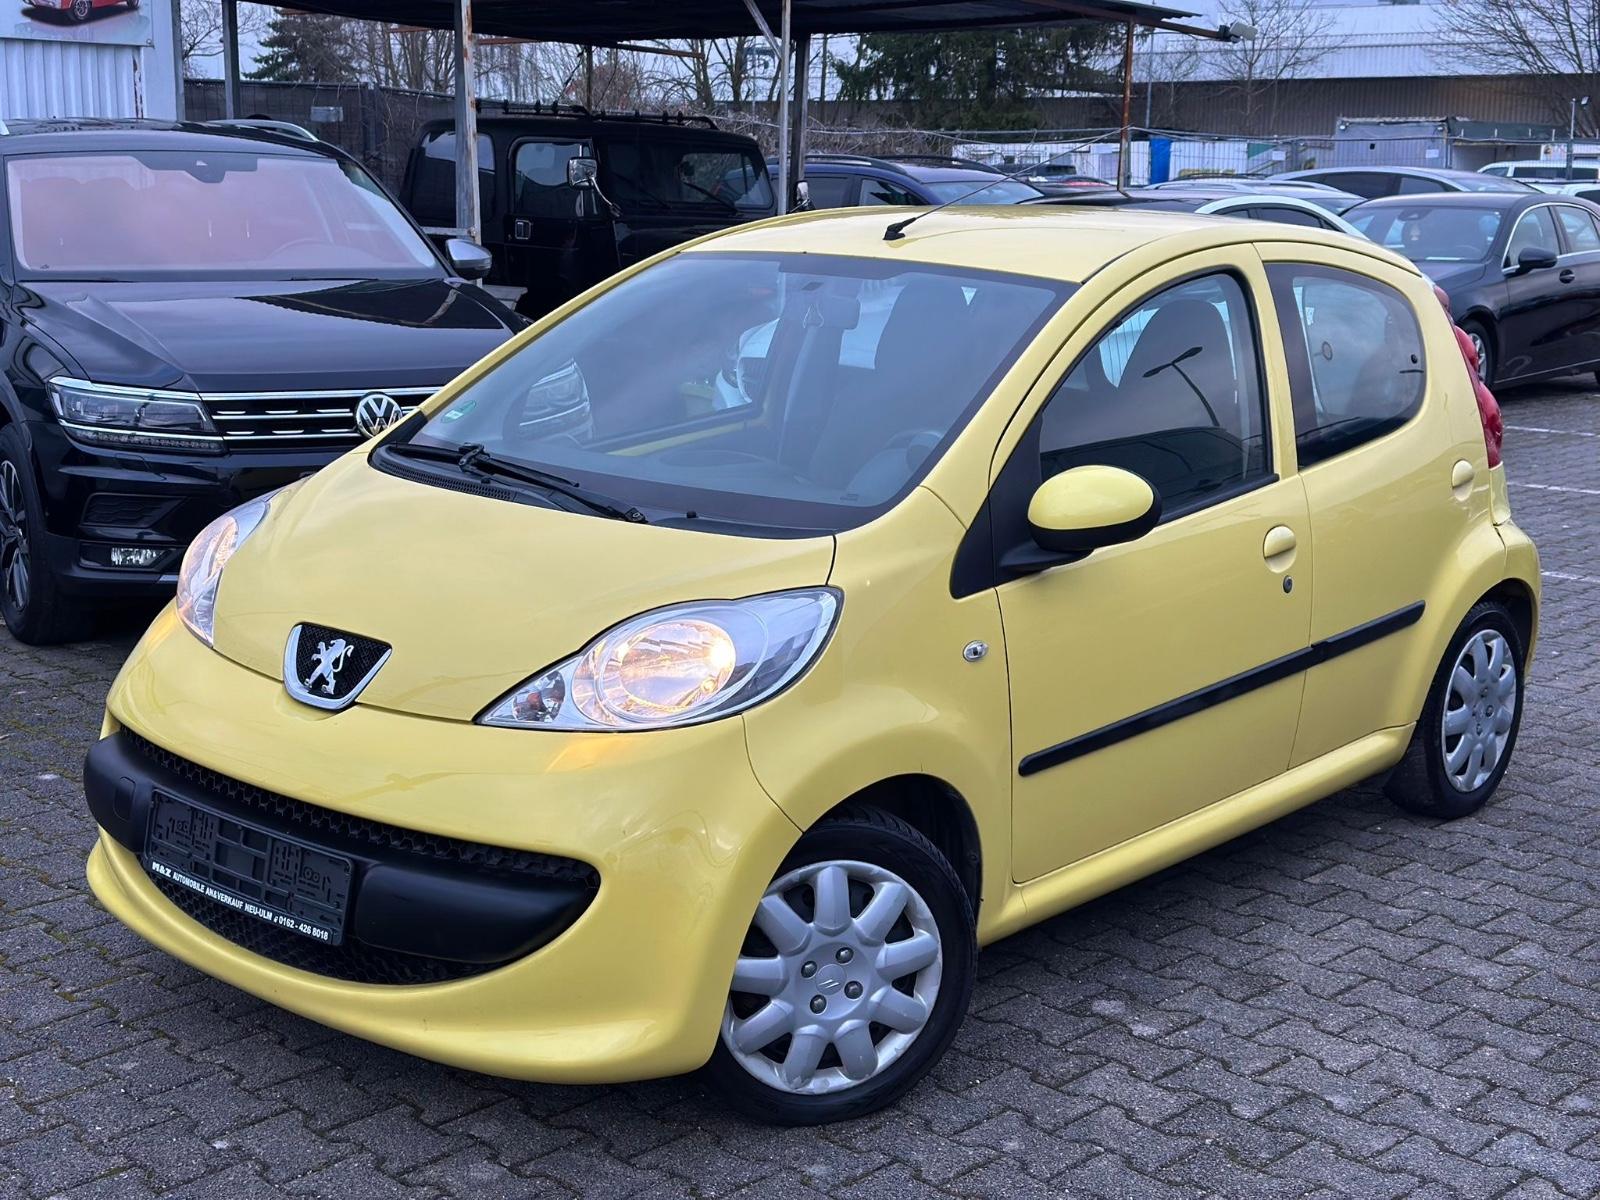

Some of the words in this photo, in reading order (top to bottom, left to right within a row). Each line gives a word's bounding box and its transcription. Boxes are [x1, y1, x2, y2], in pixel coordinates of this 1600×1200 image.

[357, 395, 402, 437] VW
[172, 871, 204, 892] AUTOMOBILE
[205, 886, 243, 908] AN&VERKAUF
[244, 903, 273, 921] NEU-ULM
[278, 915, 295, 929] 0162
[298, 923, 312, 935] 426
[312, 927, 329, 941] 8018
